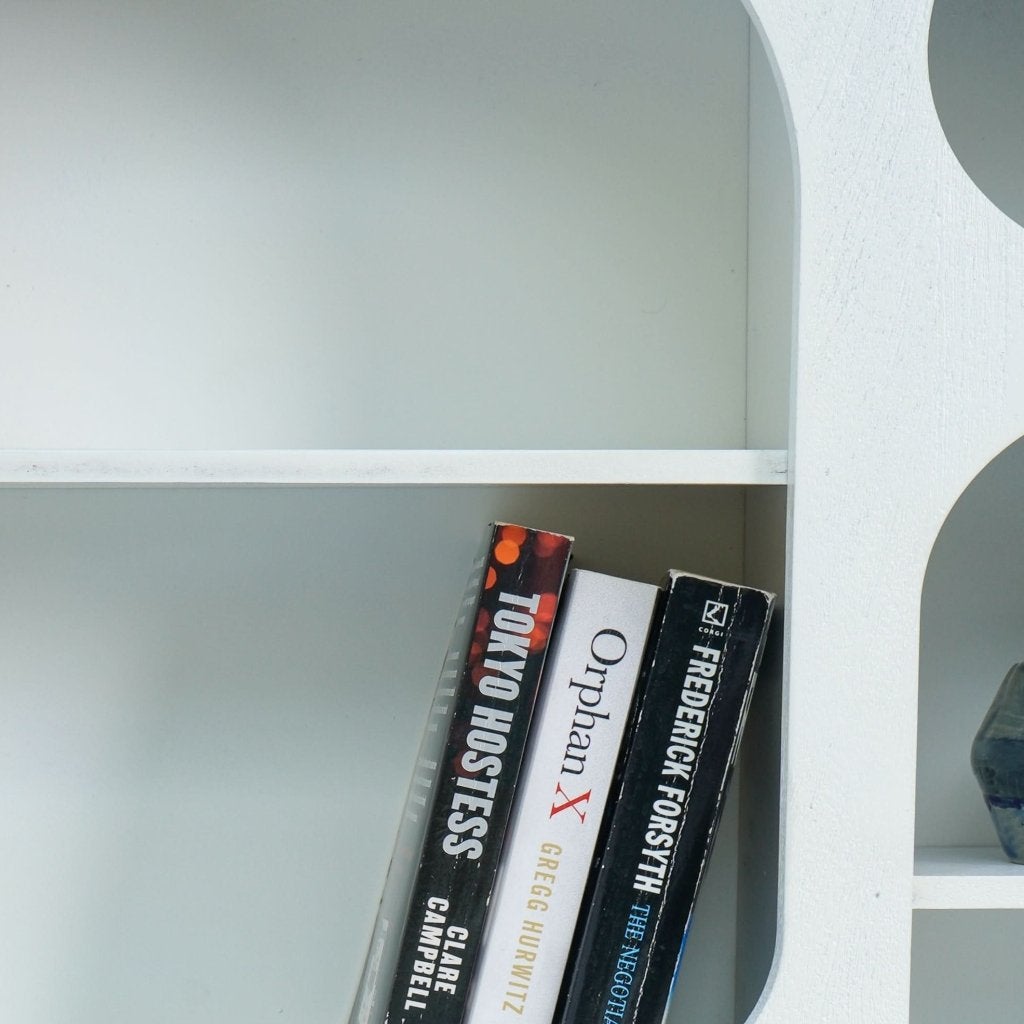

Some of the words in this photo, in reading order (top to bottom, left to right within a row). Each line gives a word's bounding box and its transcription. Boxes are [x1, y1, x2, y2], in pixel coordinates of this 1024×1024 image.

[477, 592, 541, 701] TOKYO
[698, 626, 724, 637] CORGI
[560, 628, 628, 776] Orphan
[662, 644, 721, 781] FREDERICK
[442, 704, 514, 860] HOSTESS
[549, 782, 592, 824] X
[527, 842, 563, 913] GREGG
[633, 784, 686, 895] FORSYTH
[404, 896, 449, 1011] CAMPBELL
[433, 925, 469, 995] CLARE
[502, 919, 544, 1015] HURWITZ
[624, 903, 650, 942] THE
